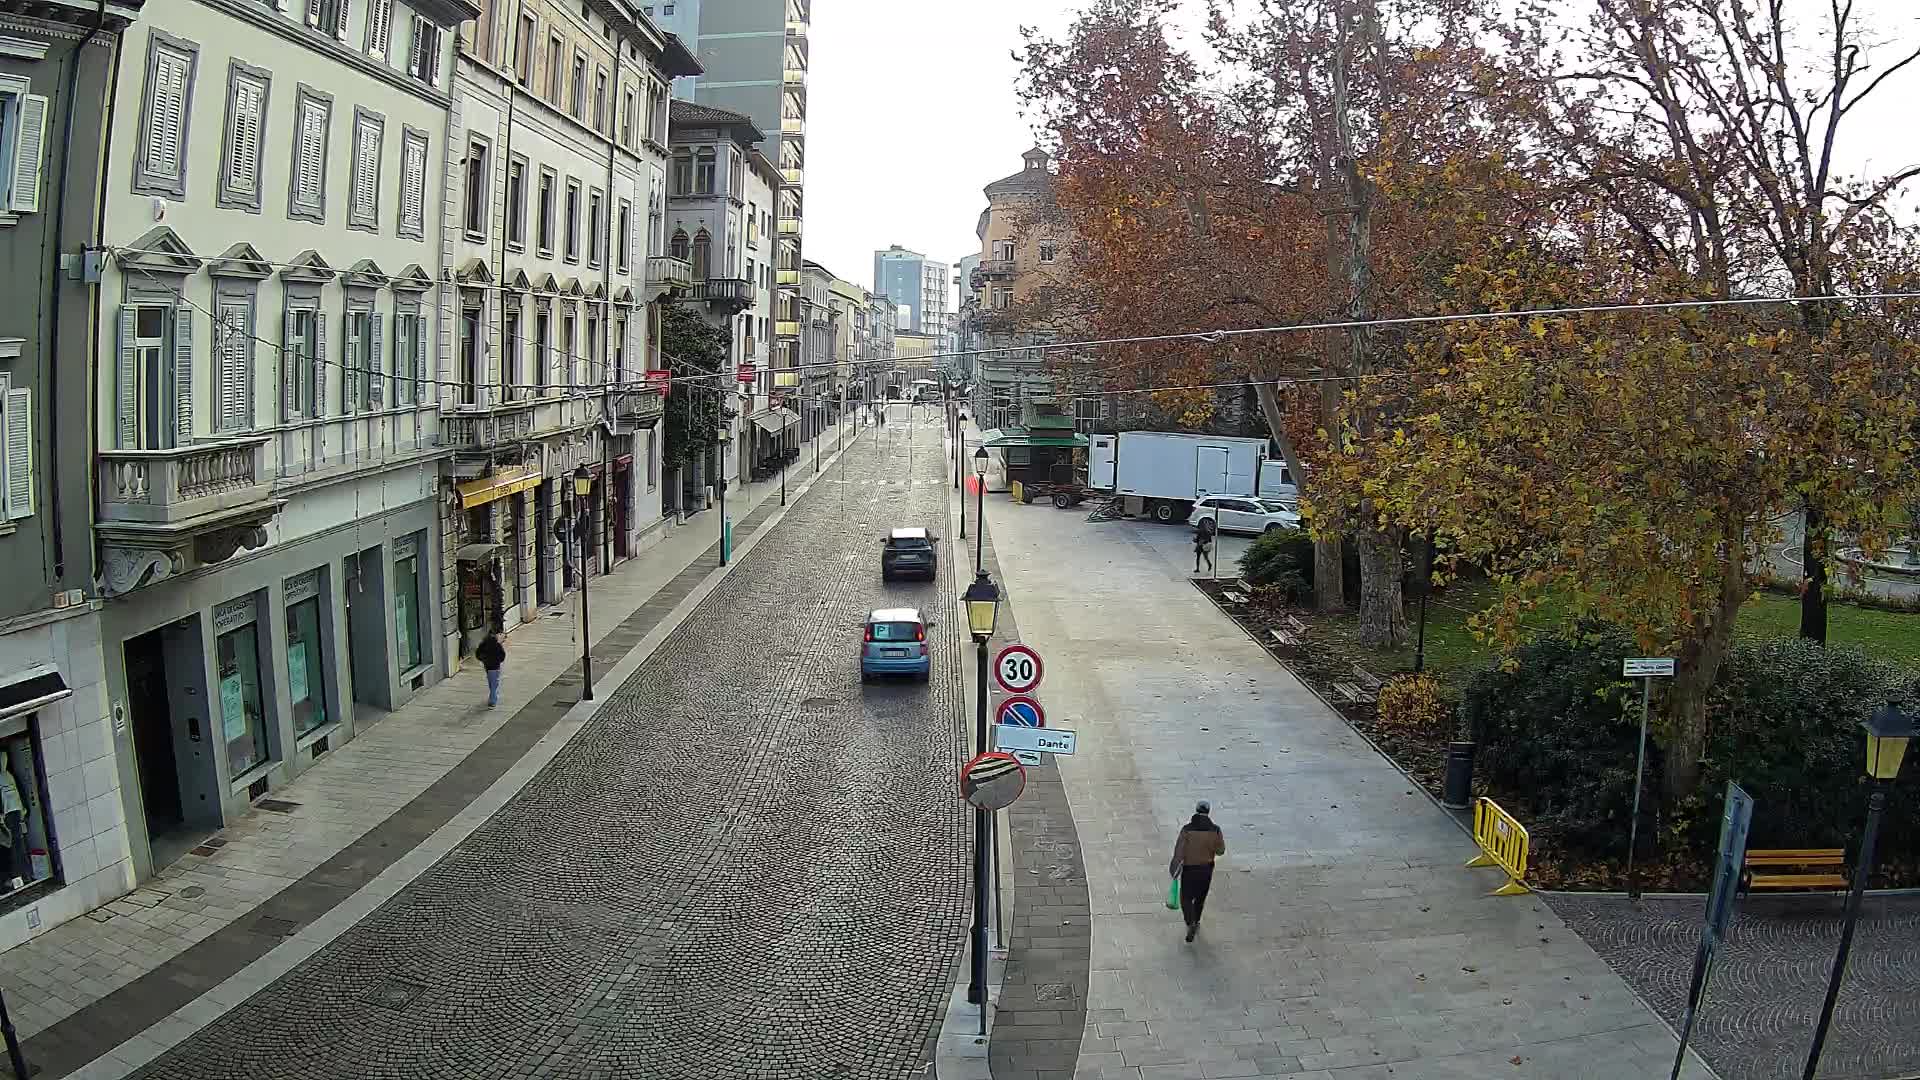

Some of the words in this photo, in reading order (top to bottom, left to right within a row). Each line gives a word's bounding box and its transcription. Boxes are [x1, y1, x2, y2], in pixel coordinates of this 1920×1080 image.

[876, 625, 886, 637] P
[1005, 658, 1033, 681] 30
[1038, 738, 1070, 750] Dante
